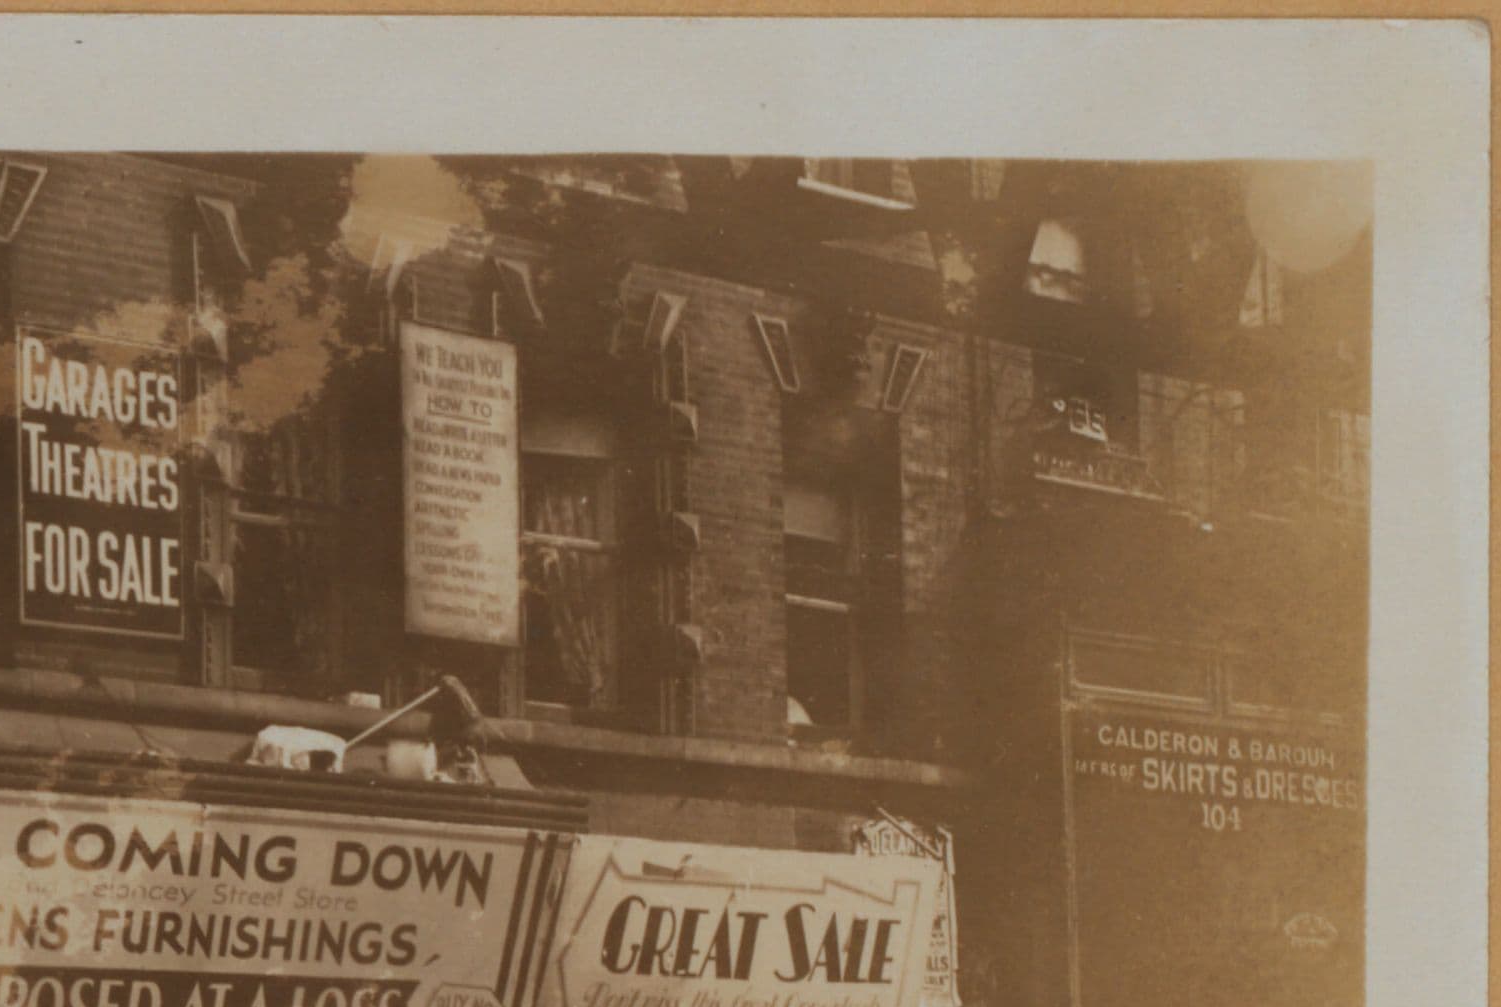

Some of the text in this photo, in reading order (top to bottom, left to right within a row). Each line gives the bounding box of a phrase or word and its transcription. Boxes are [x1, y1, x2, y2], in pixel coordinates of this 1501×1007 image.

[20, 336, 179, 430] GARAGES
[477, 353, 503, 379] YOU
[427, 394, 493, 418] HOW TO
[21, 421, 179, 511] THEATRES
[25, 521, 180, 606] FOR SALE
[1098, 724, 1219, 757] CALDERON
[1227, 738, 1242, 760] &
[1142, 757, 1238, 798] SKIRTS
[1201, 801, 1242, 832] 104
[15, 817, 298, 885] COMING
[331, 840, 495, 909] DOWN
[211, 883, 285, 908] Street
[294, 886, 360, 912] Store
[92, 908, 418, 967] FURNISHINGS
[601, 894, 901, 984] GREAT SALE
